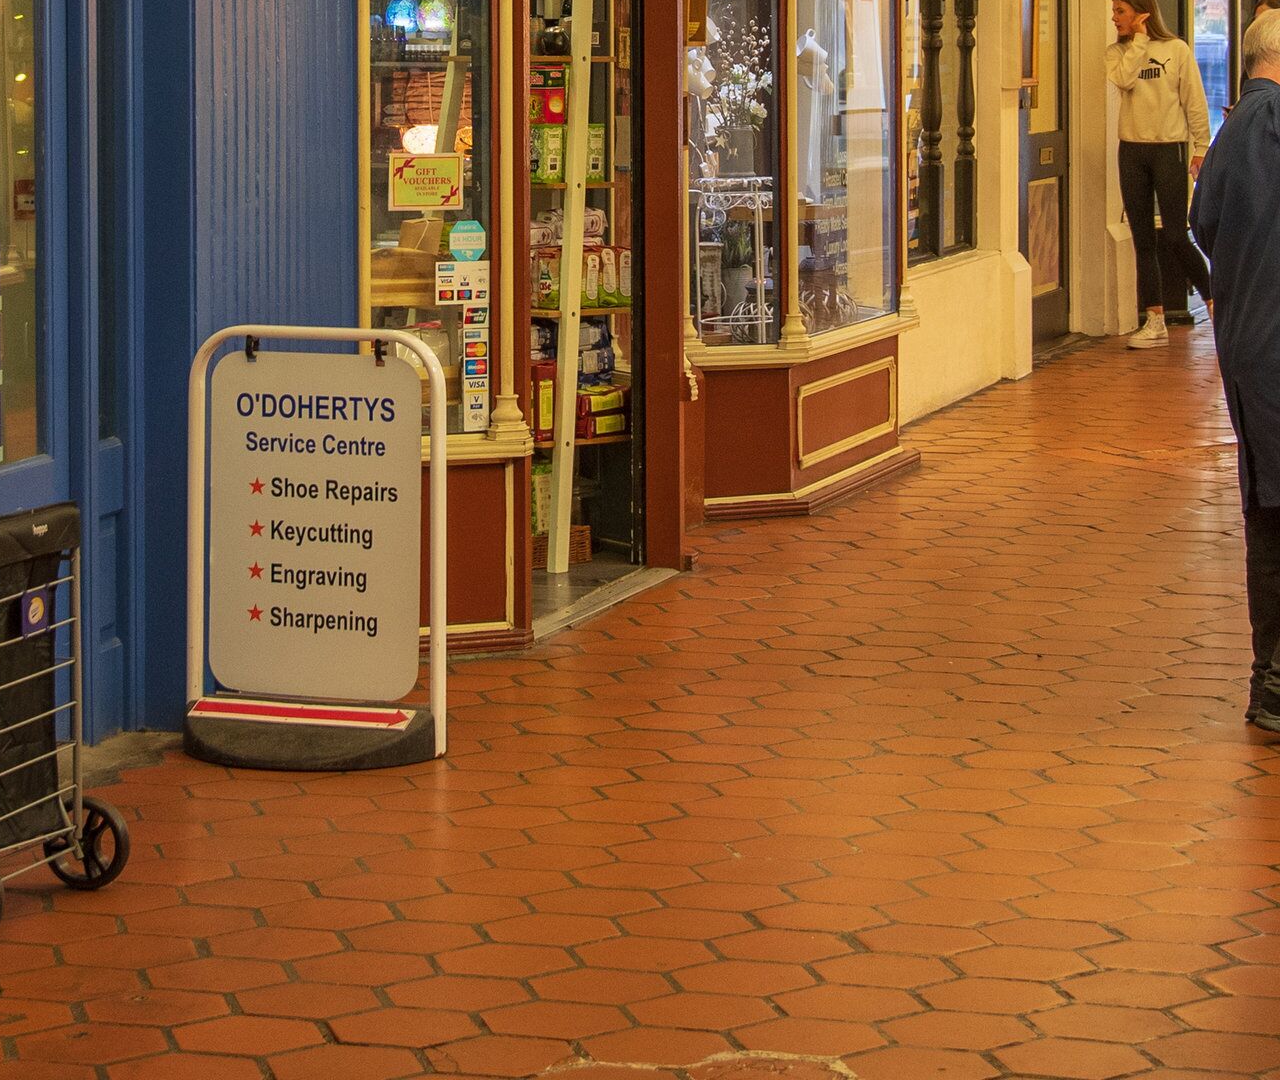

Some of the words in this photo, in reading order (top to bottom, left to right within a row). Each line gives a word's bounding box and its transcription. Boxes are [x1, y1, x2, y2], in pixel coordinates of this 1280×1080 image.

[1137, 67, 1161, 80] UMA
[402, 176, 452, 185] VOUCHERS
[415, 167, 438, 176] GIFT
[468, 380, 486, 389] VISA
[236, 392, 397, 423] O'DOHERTYS
[245, 430, 317, 455] Service
[322, 433, 387, 457] Centre
[270, 476, 319, 500] Shoe
[325, 478, 399, 507] Repairs
[270, 520, 374, 550] Keycutting
[270, 563, 368, 593] Engraving
[269, 605, 379, 637] Sharpening
